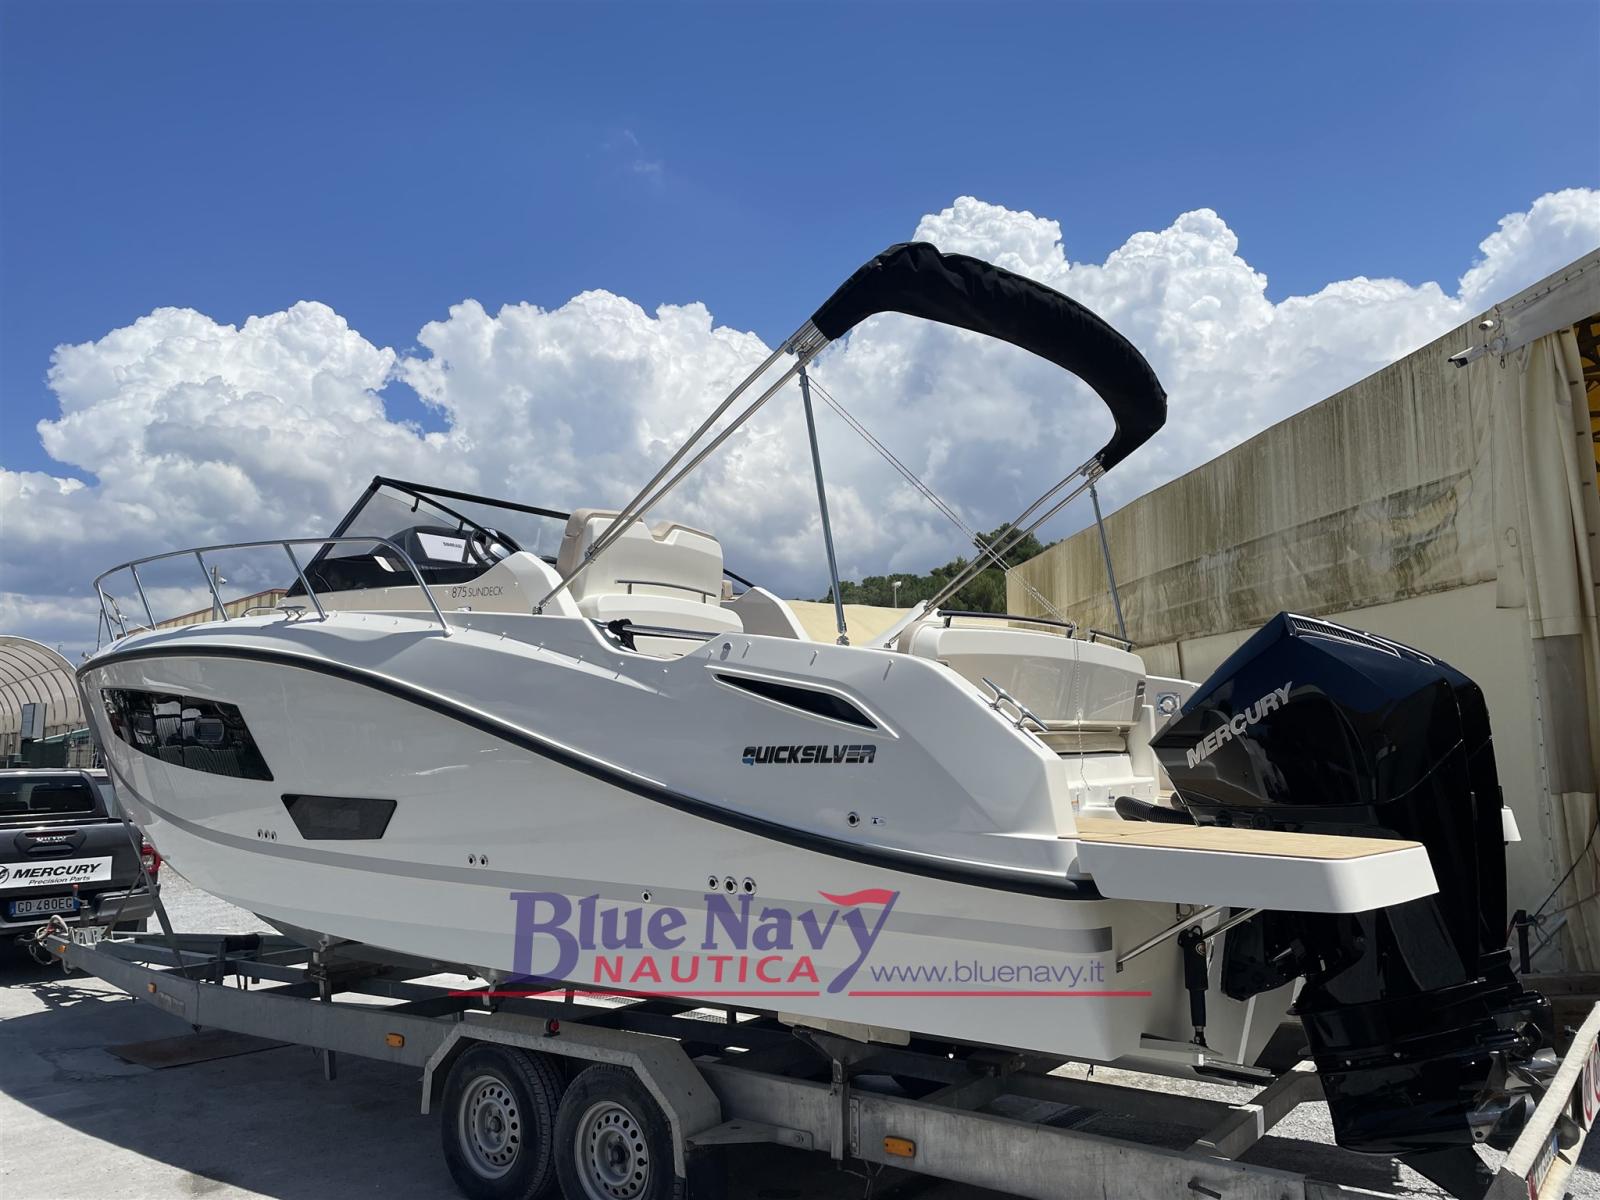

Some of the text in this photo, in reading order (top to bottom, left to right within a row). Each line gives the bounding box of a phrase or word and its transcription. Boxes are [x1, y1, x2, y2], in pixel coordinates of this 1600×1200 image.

[451, 586, 503, 599] 875 SUNDECK
[1186, 681, 1294, 769] MERCURY
[742, 744, 877, 766] QUICKSILVER
[12, 862, 102, 879] MERCURY
